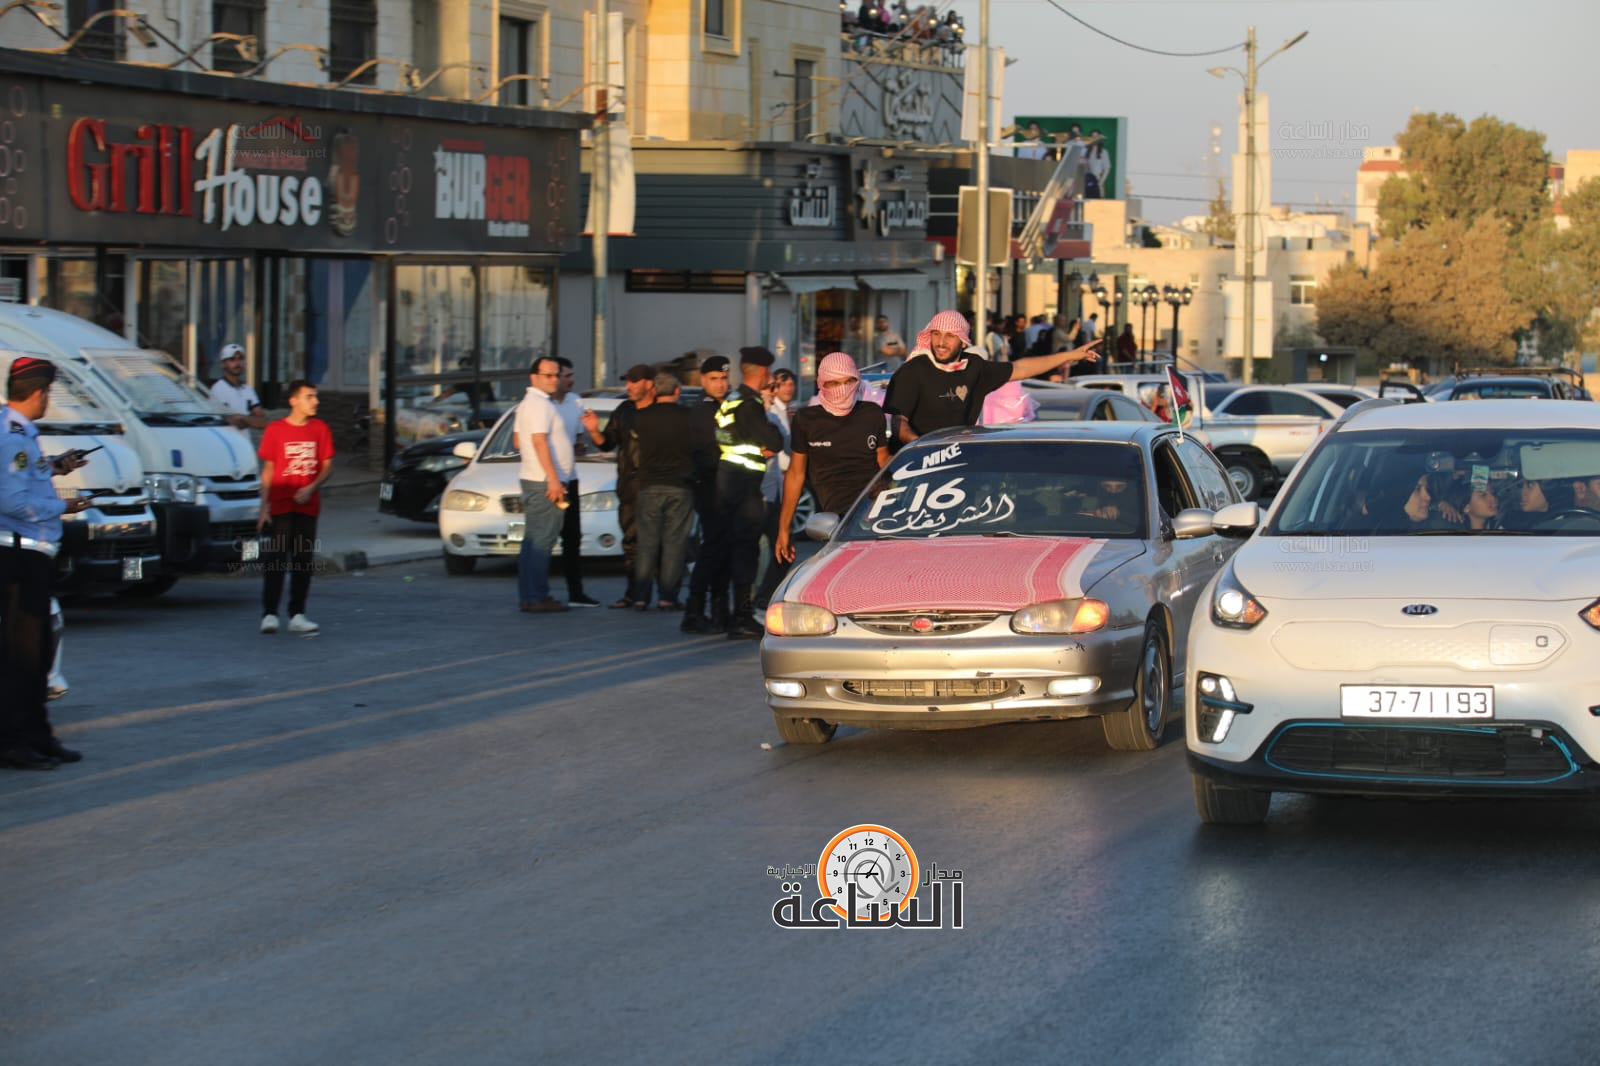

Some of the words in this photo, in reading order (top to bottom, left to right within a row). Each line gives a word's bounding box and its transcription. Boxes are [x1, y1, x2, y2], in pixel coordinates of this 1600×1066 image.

[67, 117, 194, 216] Grill
[194, 123, 323, 232] House
[433, 150, 531, 221] BURGER
[922, 442, 962, 470] NIKE
[1406, 604, 1434, 614] KIA
